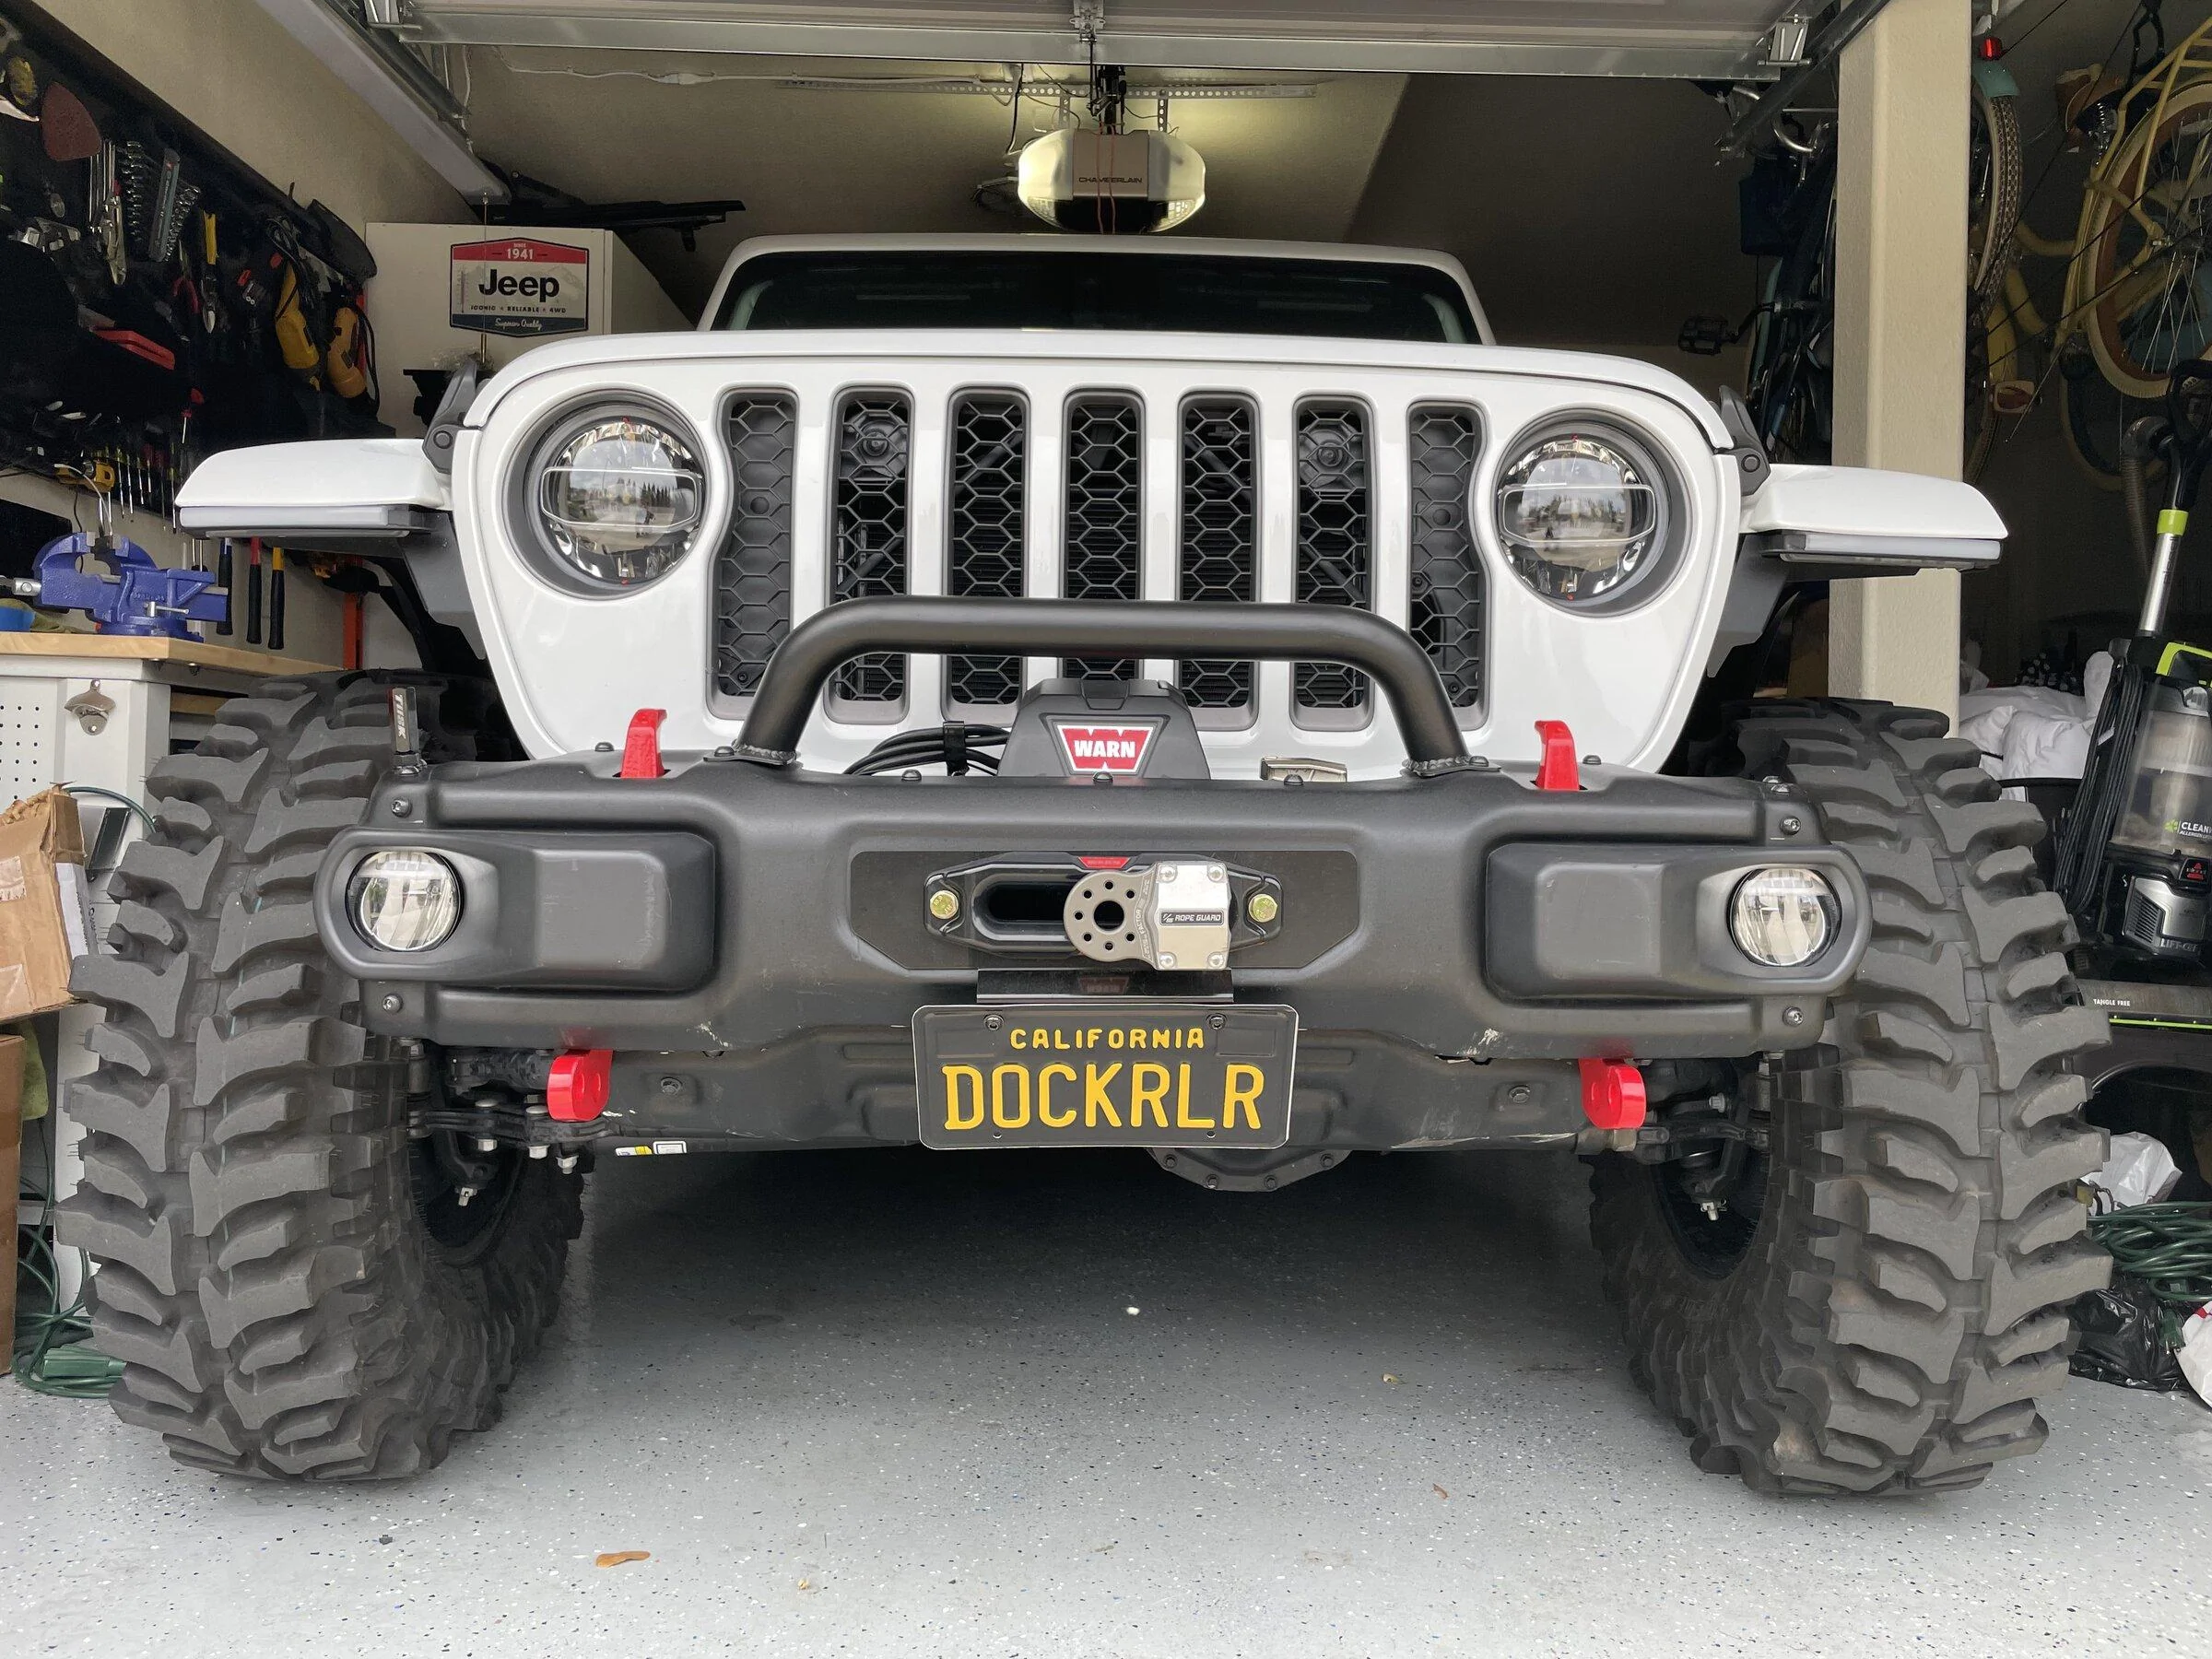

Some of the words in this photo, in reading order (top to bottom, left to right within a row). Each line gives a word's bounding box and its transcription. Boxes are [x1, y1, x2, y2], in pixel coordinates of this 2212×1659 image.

[507, 248, 534, 260] 1941
[478, 269, 559, 302] Jeep
[394, 694, 406, 739] TUSK
[1074, 740, 1135, 758] WARN
[1135, 909, 1147, 935] FACTOR
[2093, 998, 2116, 1006] TANGLE
[1009, 1027, 1205, 1050] CALIFORNIA
[941, 1062, 1265, 1130] DOCKRLR
